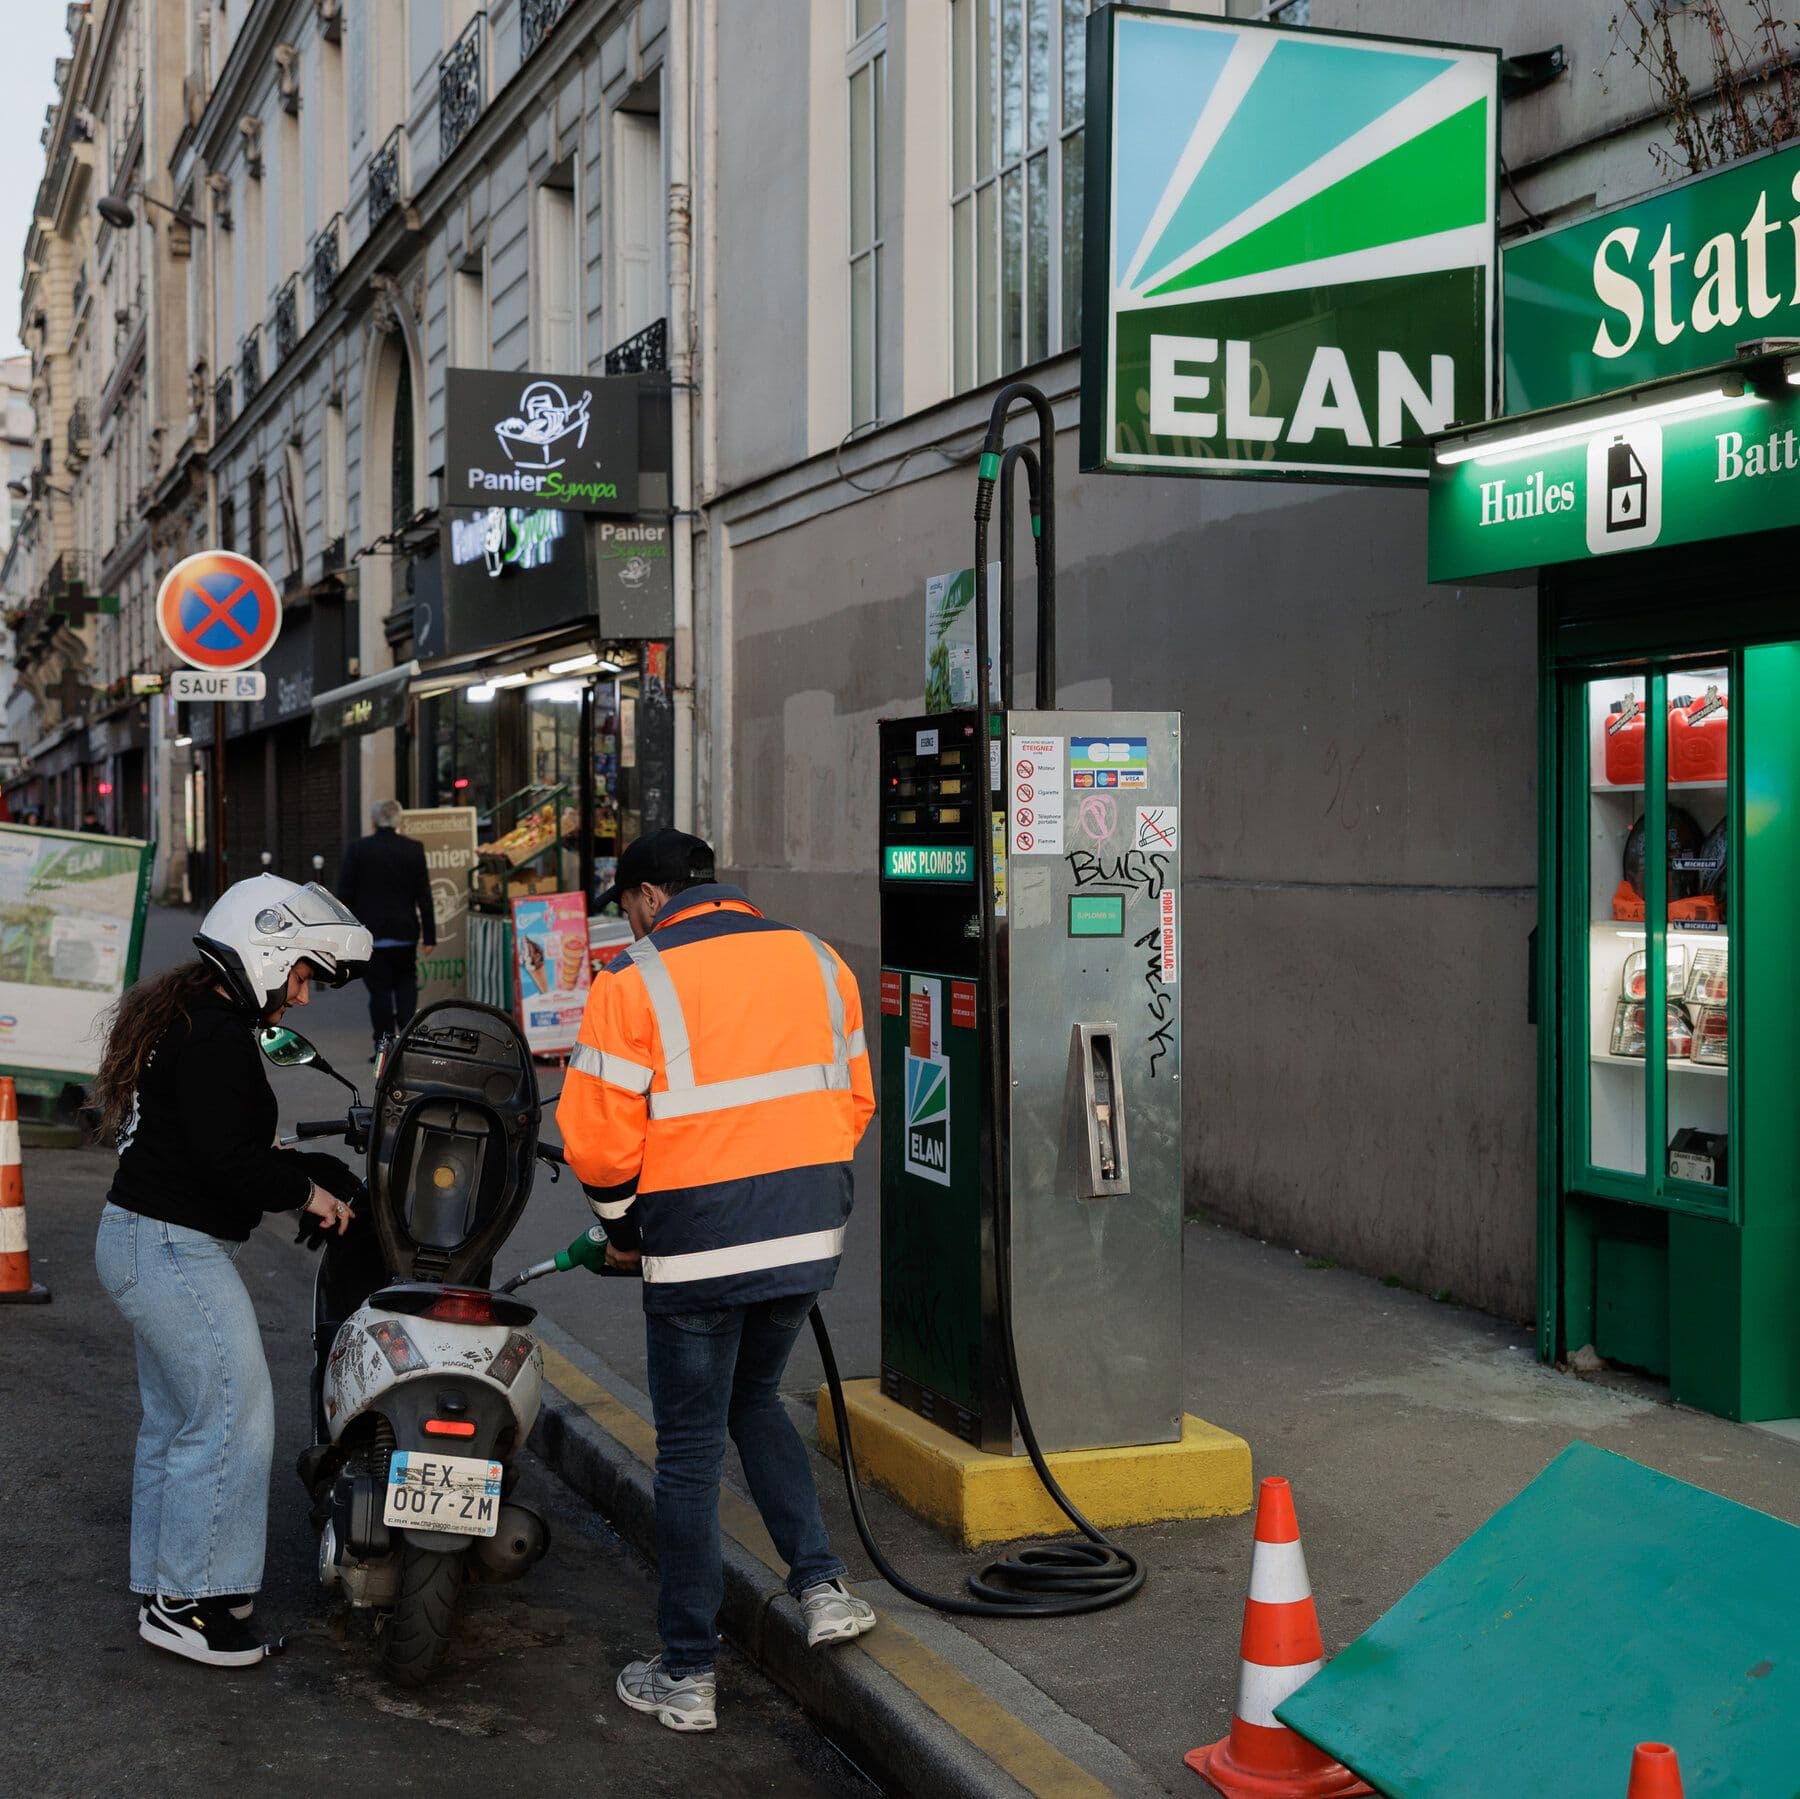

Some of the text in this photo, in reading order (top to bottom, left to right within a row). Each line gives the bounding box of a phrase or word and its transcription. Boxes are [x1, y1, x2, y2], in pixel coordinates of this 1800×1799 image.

[1150, 334, 1455, 449] ELAN
[1714, 429, 1800, 483] Batt
[1479, 470, 1575, 527] Huiles
[601, 523, 665, 541] Panier
[179, 678, 229, 694] SAUF
[66, 850, 104, 875] ELAN
[892, 851, 966, 874] SANS PLOMB 95
[1163, 892, 1173, 913] FIORI
[1163, 916, 1173, 926] DI
[1163, 928, 1174, 969] CADILLAC
[911, 1132, 944, 1168] ELAN
[442, 1361, 475, 1370] PIAGGIO
